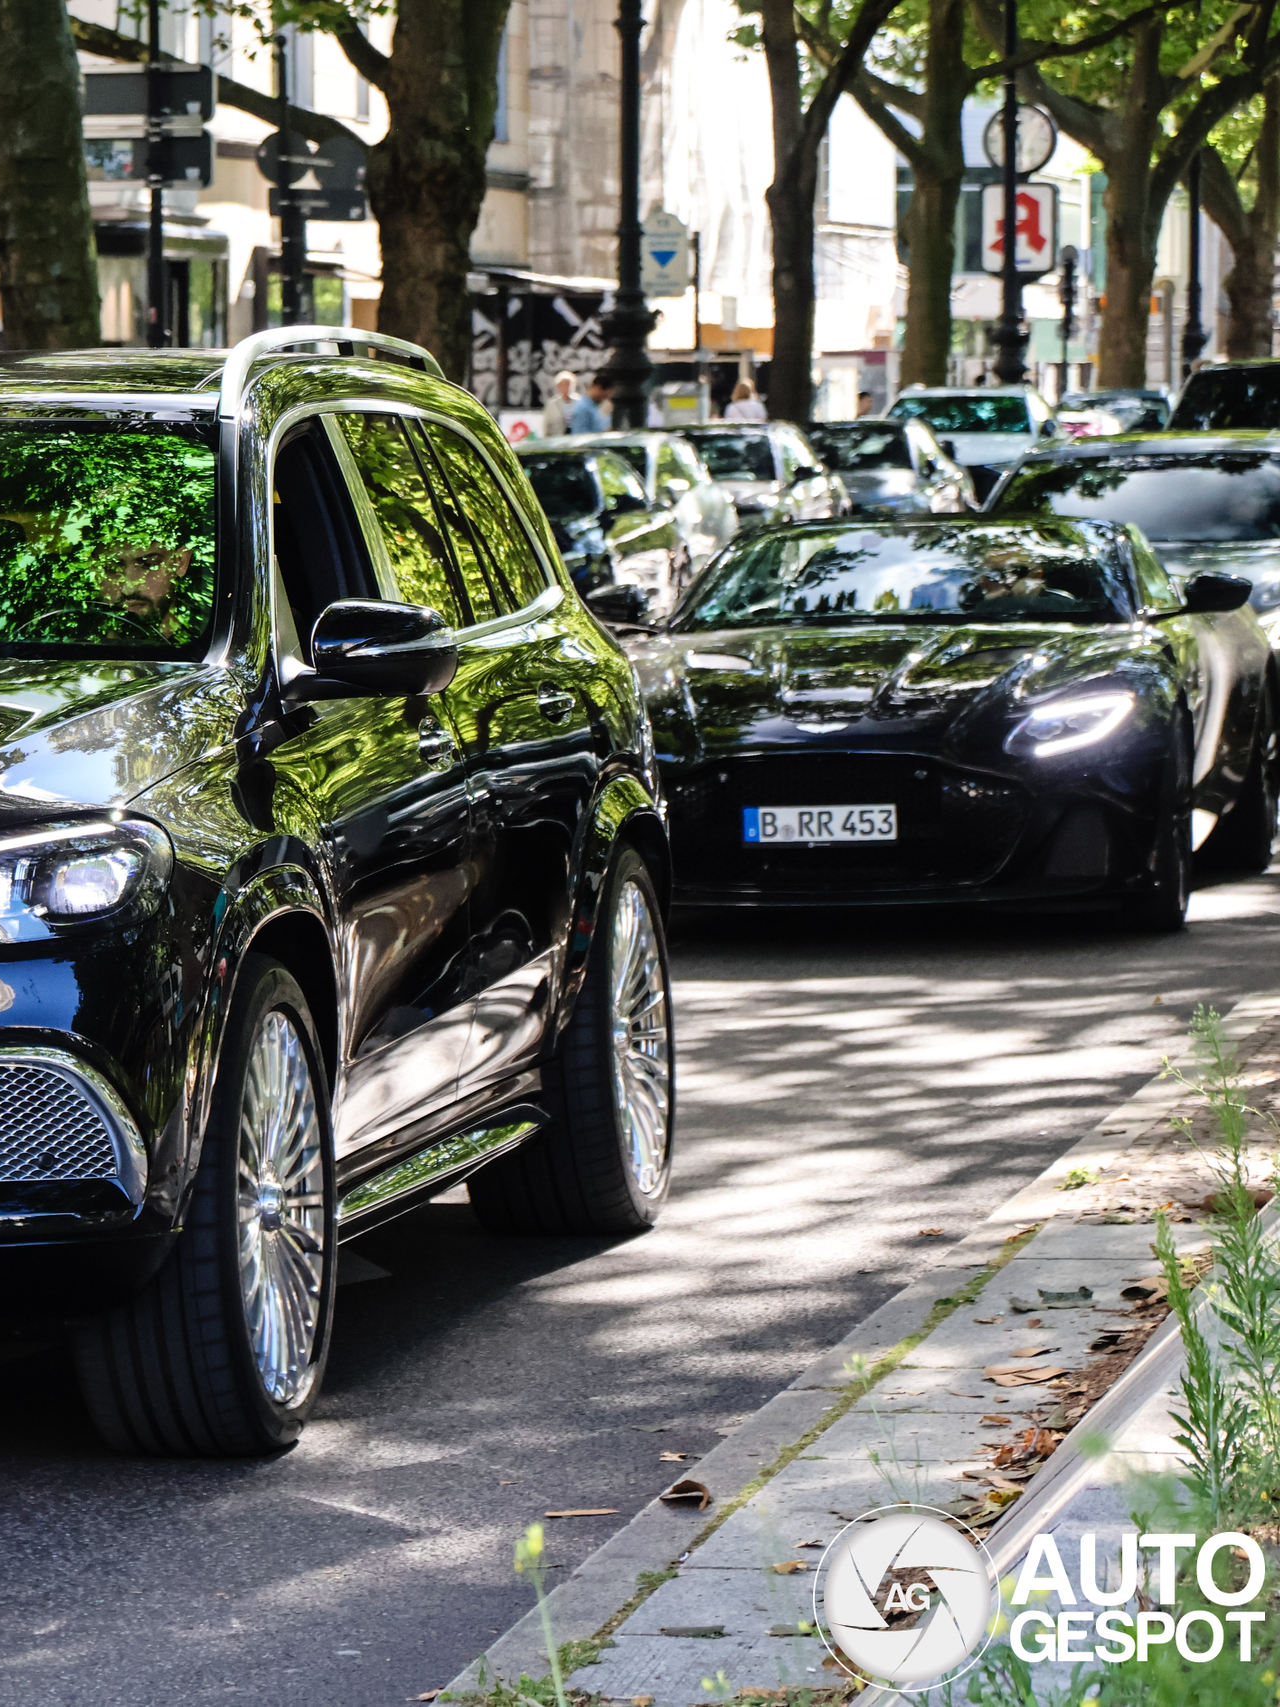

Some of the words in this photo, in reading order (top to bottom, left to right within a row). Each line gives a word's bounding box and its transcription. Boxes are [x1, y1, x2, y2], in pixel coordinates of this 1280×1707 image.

[761, 812, 779, 838] B
[798, 811, 834, 837] RR
[841, 810, 894, 837] 453
